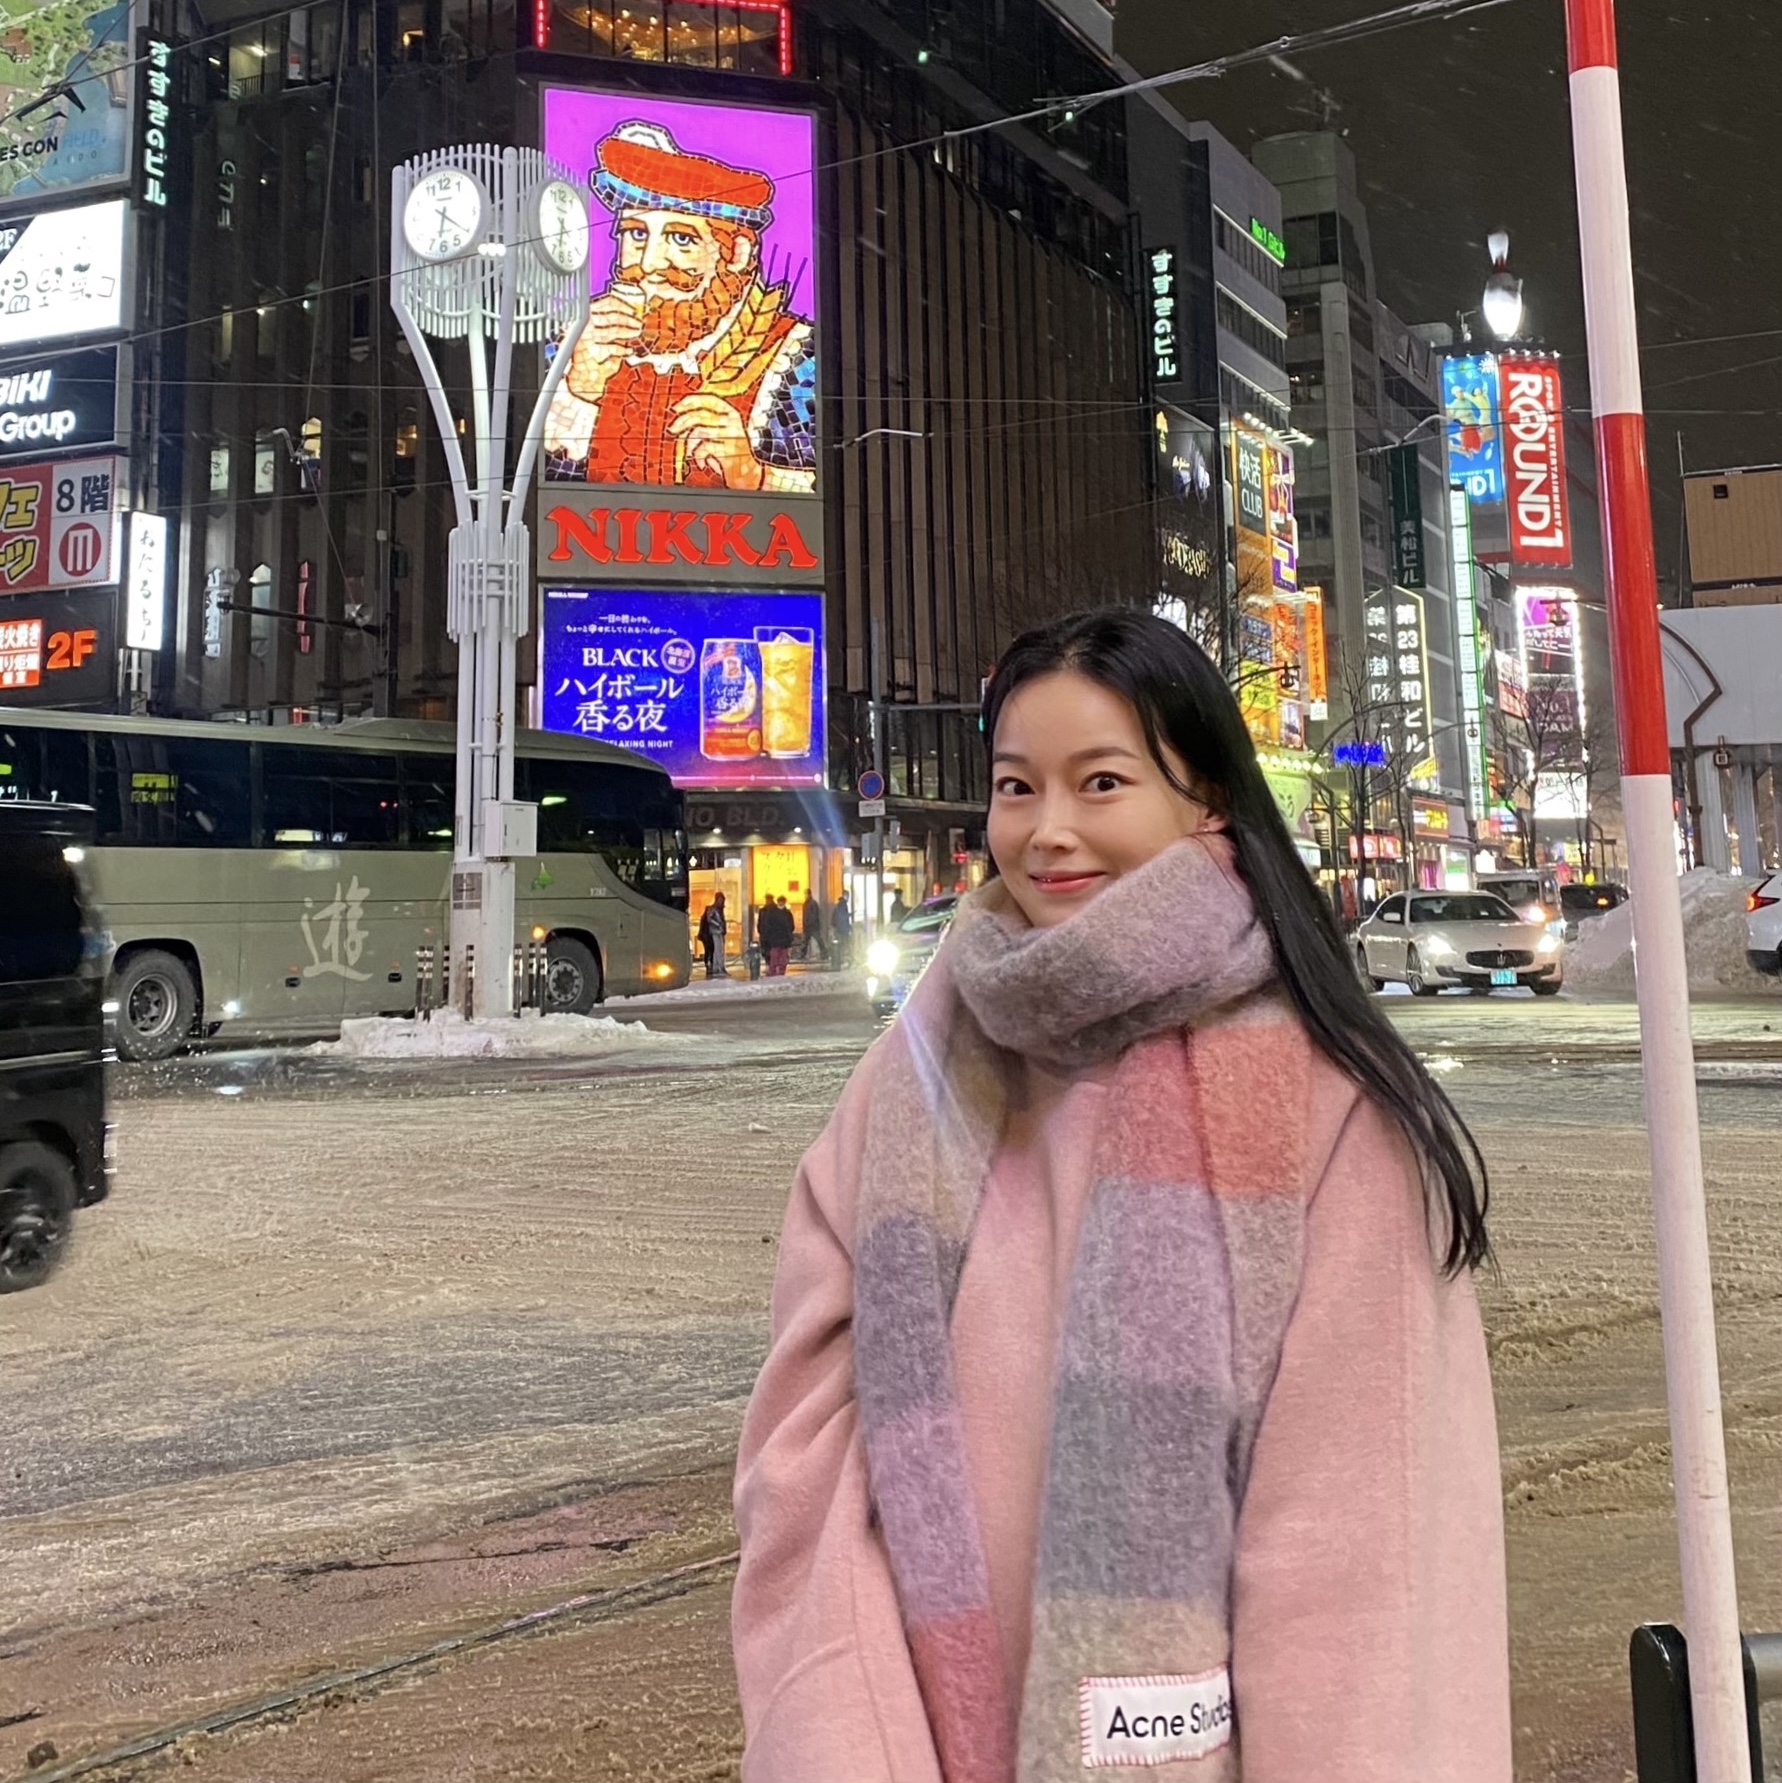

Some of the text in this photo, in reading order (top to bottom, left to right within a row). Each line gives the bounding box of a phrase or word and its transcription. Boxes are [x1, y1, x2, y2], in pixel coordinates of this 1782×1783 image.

[0, 410, 77, 442] Group
[1508, 372, 1565, 548] ROUND1
[1548, 426, 1562, 527] ENTERTAINMENT
[56, 473, 110, 514] 8階
[1241, 488, 1263, 519] CLUB
[545, 505, 818, 568] NIKKA
[46, 629, 98, 669] 2F
[582, 648, 659, 667] BLACK
[555, 673, 685, 699] ハイボール
[572, 699, 668, 732] 香る夜
[648, 740, 673, 748] NIGHT
[1106, 1705, 1185, 1739] Acne
